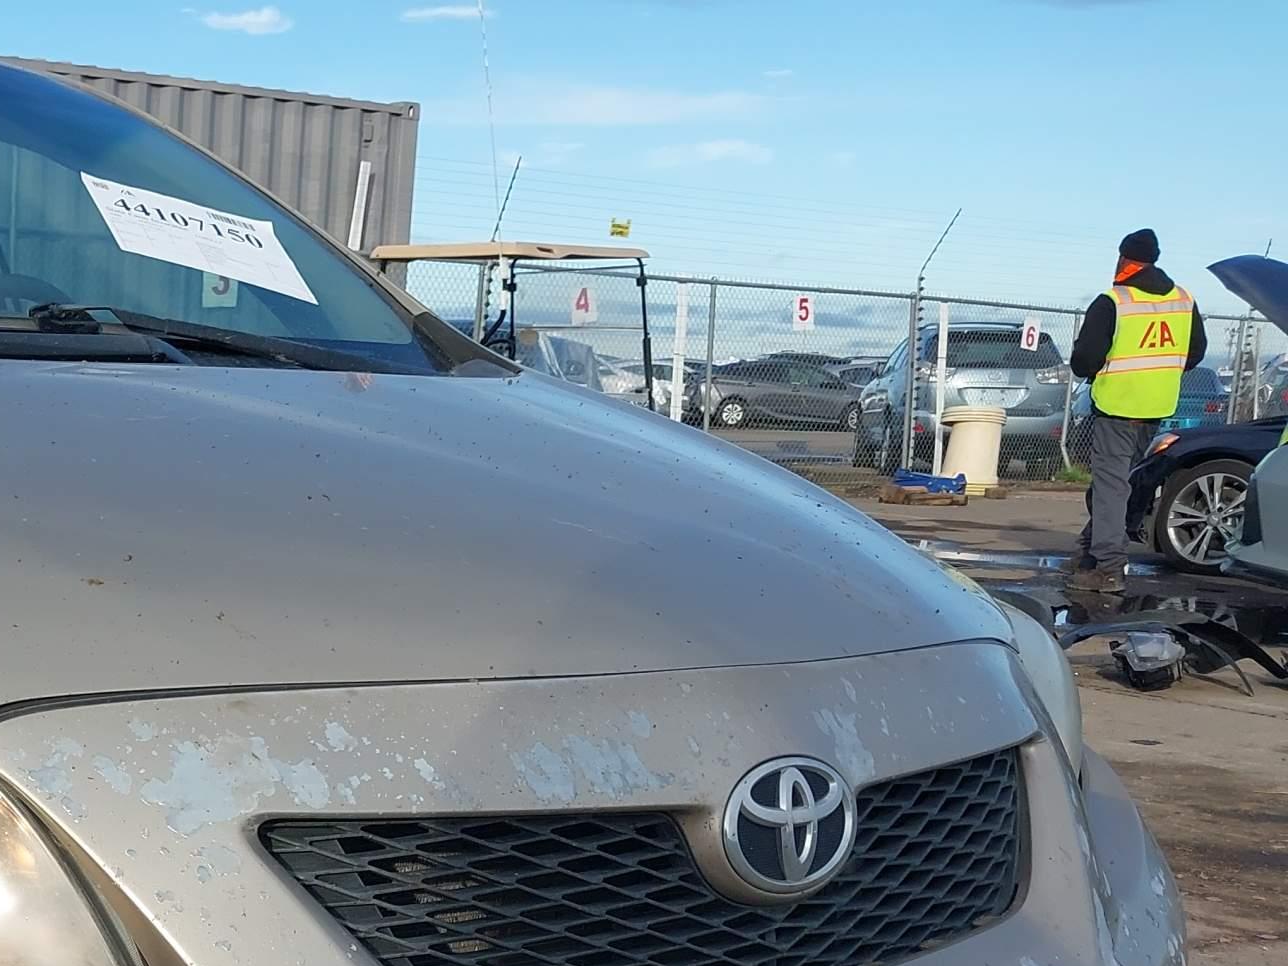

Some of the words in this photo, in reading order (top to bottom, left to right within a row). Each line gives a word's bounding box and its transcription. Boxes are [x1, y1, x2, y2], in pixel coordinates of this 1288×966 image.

[113, 198, 264, 249] 44107150
[575, 287, 589, 313] 4
[798, 297, 809, 322] 5
[1025, 326, 1036, 348] 6
